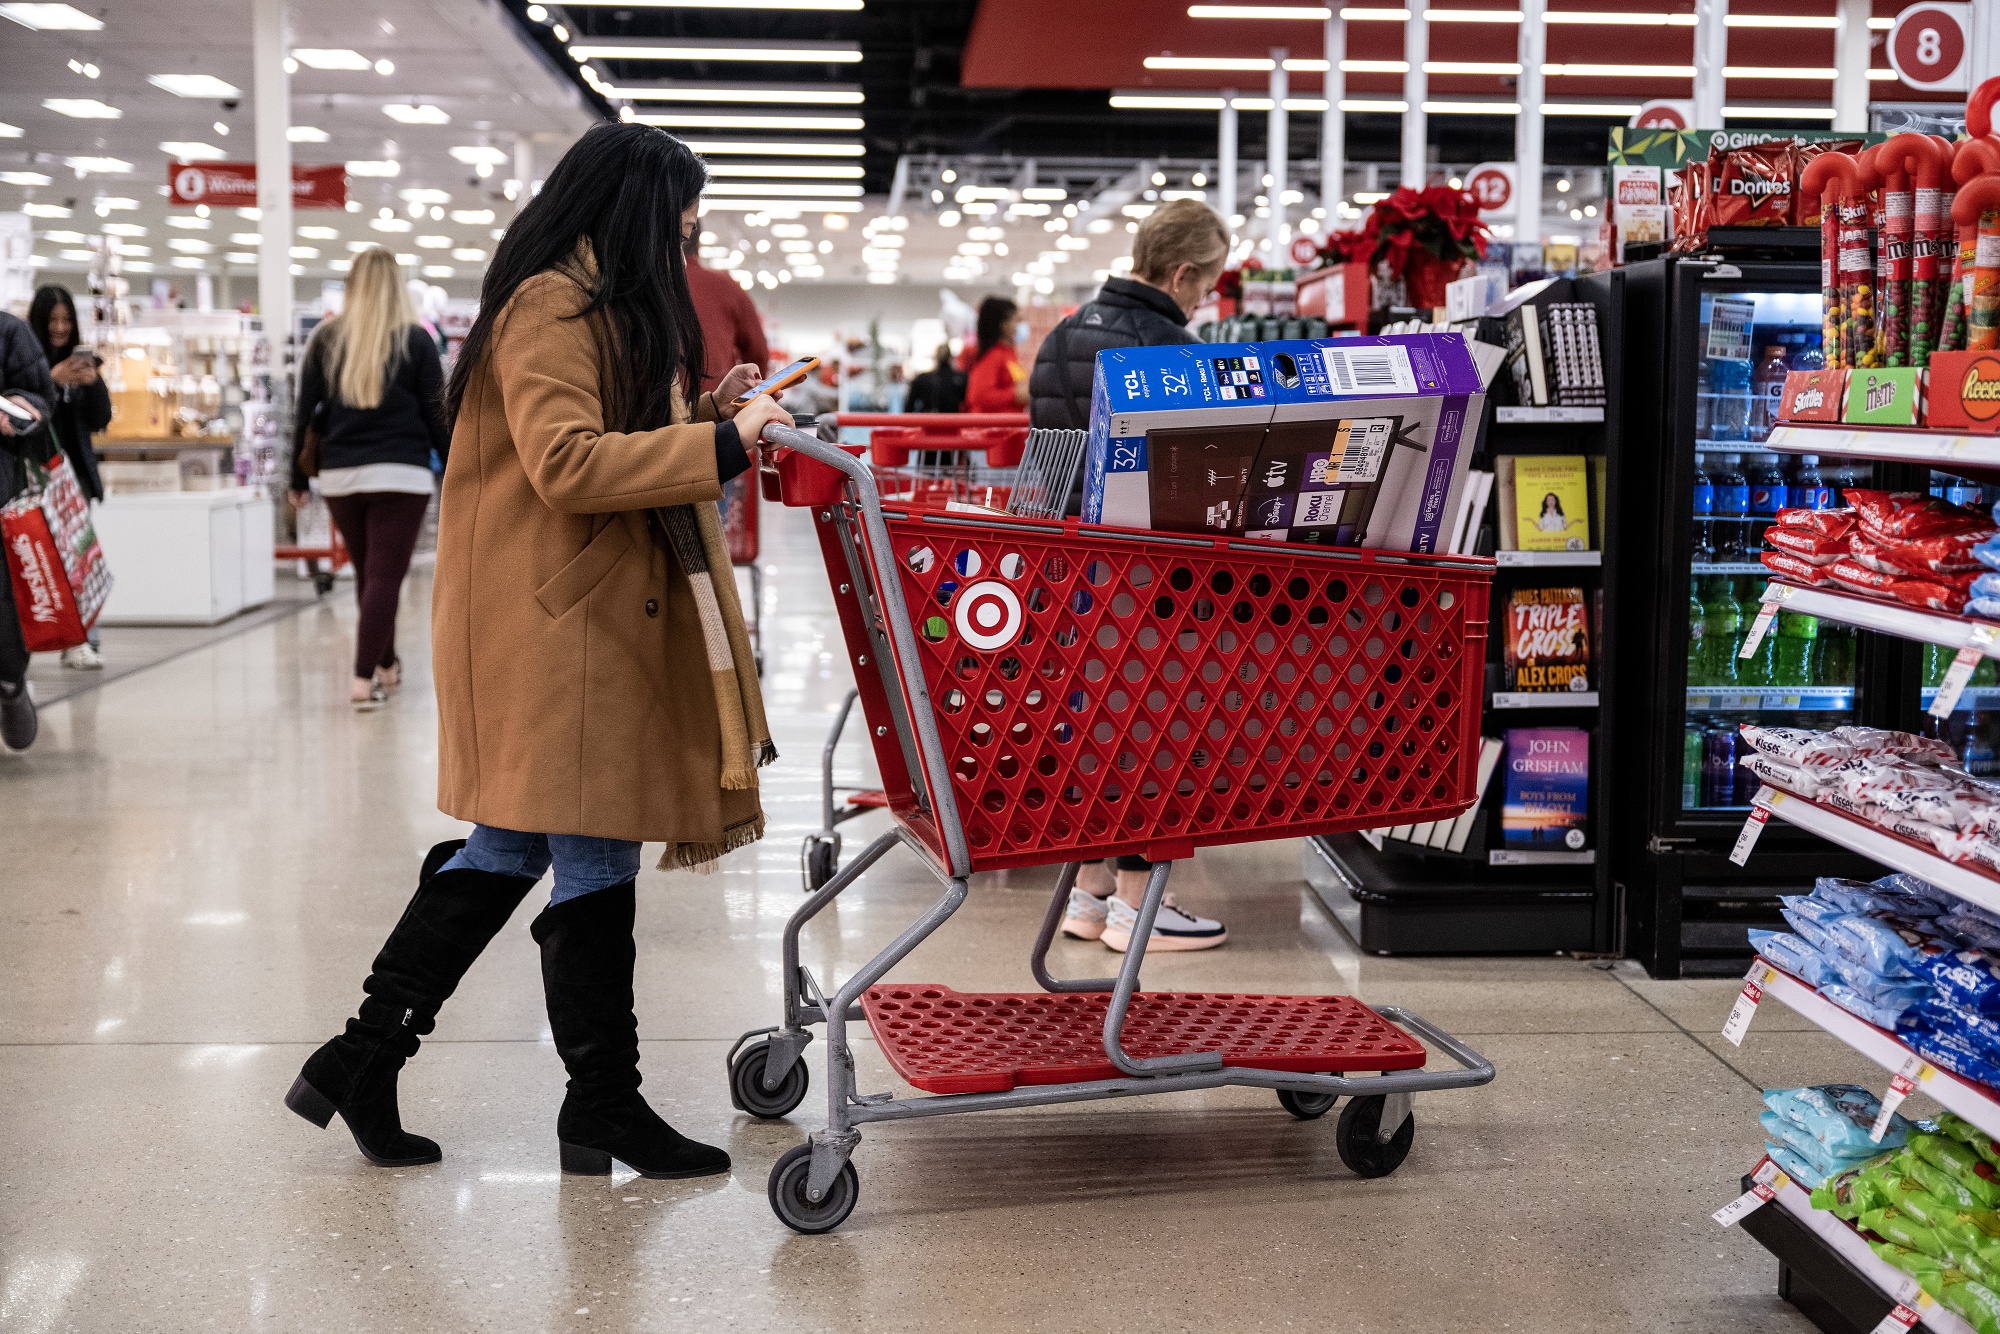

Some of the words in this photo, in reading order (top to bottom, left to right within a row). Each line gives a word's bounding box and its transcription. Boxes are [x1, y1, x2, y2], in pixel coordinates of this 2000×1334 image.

[1917, 27, 1941, 65] 8
[1475, 177, 1507, 200] 12
[1731, 179, 1791, 195] Doritos
[1196, 359, 1203, 368] TV
[1124, 370, 1140, 400] TCL
[1139, 370, 1147, 384] more
[1142, 384, 1150, 398] enjoy
[1203, 387, 1212, 401] TCL
[1794, 387, 1824, 414] Skittles
[1371, 424, 1384, 432] R
[1318, 494, 1334, 522] Channel
[1515, 603, 1584, 631] TRIPLE
[1517, 628, 1577, 660] CROSS
[1517, 665, 1546, 687] ALEX
[1547, 664, 1588, 686] CROSS
[1527, 739, 1571, 756] JOHN
[1512, 758, 1584, 774] GRISHAM
[1519, 791, 1545, 801] BOYS
[1547, 791, 1577, 801] FROM
[1744, 983, 1757, 999] Sale!
[1753, 1184, 1771, 1197] Sale!
[1892, 1305, 1913, 1322] Sale!
